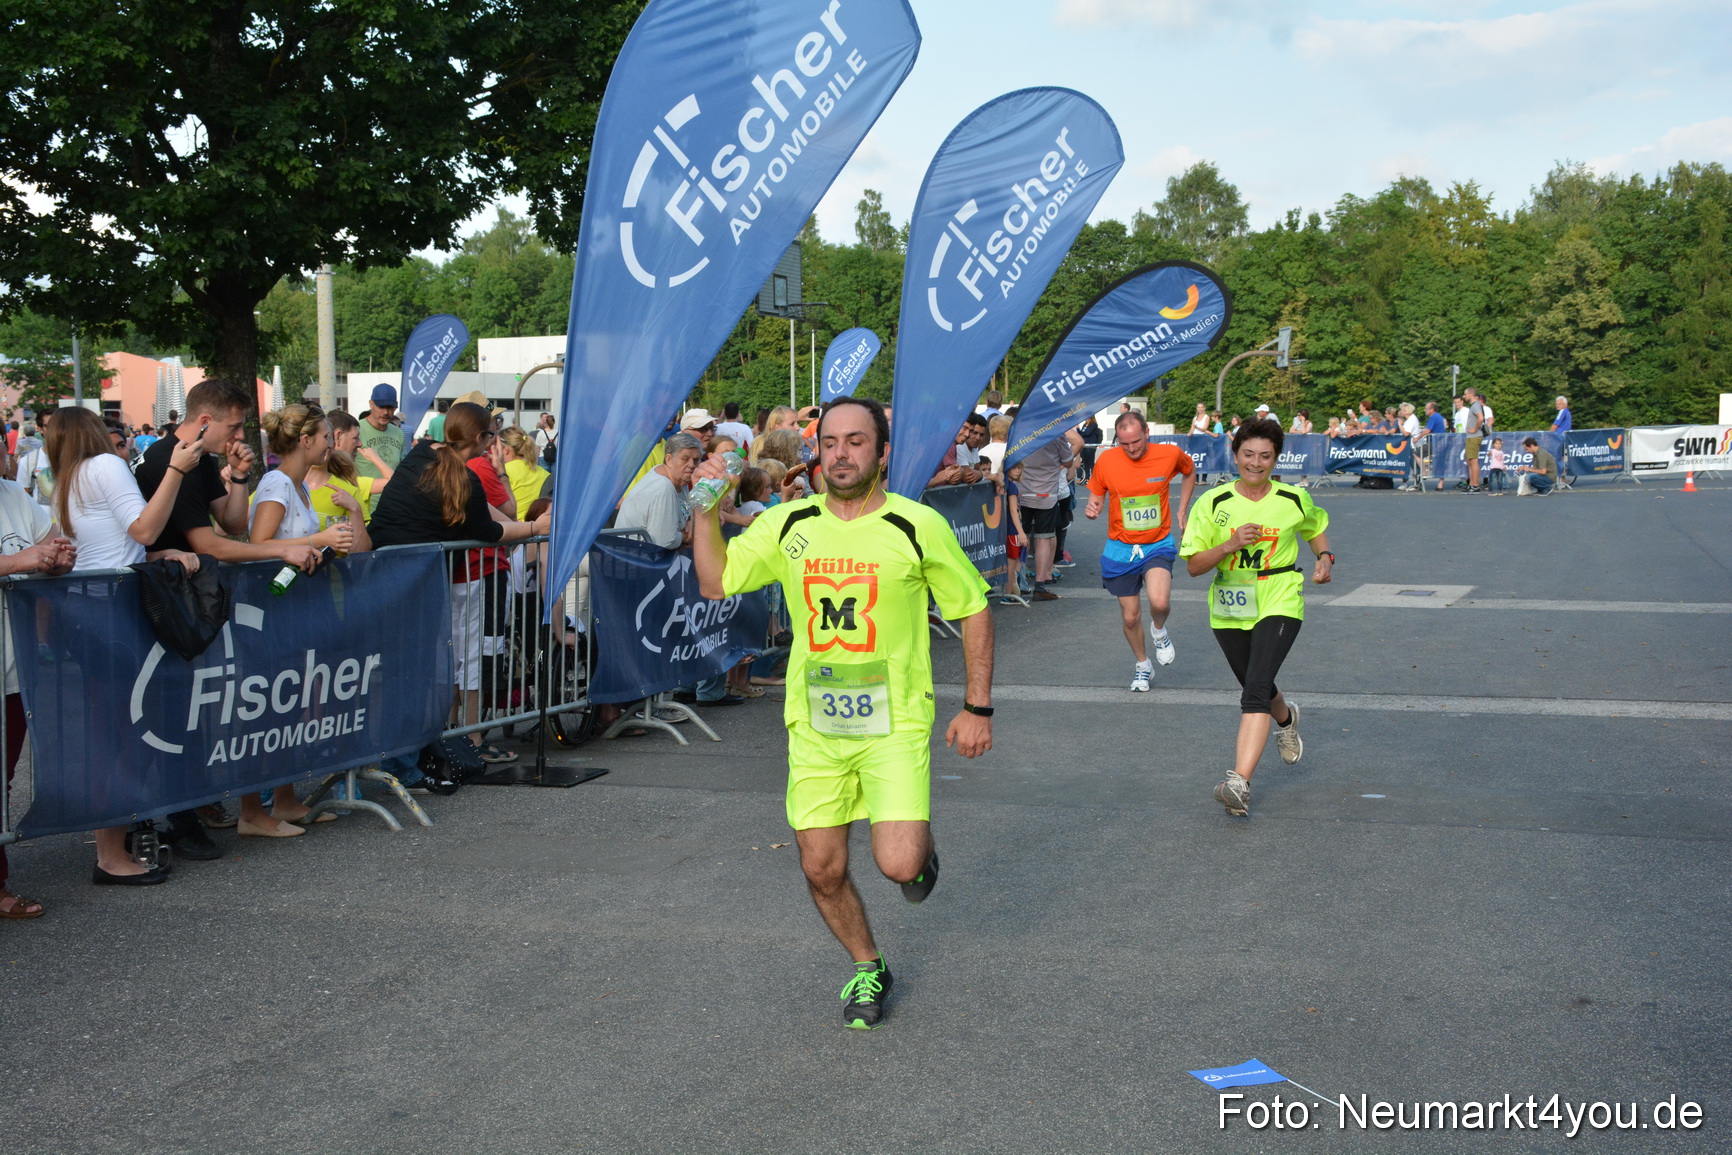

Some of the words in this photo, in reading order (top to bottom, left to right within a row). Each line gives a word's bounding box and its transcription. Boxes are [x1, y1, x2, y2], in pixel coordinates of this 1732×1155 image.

[664, 0, 848, 246] Fischer
[729, 48, 868, 245] AUTOMOBILE
[957, 126, 1075, 301] Fischer
[999, 159, 1090, 299] AUTOMOBILE
[416, 327, 454, 385] Fischer
[429, 338, 460, 384] AUTOMOBILE
[835, 338, 868, 386] Fischer
[1041, 322, 1174, 403] Frischmann
[1126, 347, 1159, 369] Druck
[1159, 337, 1181, 352] und
[1180, 313, 1219, 342] Medien
[846, 346, 872, 385] AUTOMOBILE
[1004, 400, 1087, 460] www.frischmann-net.de
[1329, 447, 1387, 459] Frischmann
[1568, 443, 1610, 457] Frischmann
[1673, 437, 1717, 457] swn
[1277, 451, 1308, 463] cher
[1126, 508, 1157, 521] 1040
[803, 558, 880, 575] Müller
[1238, 549, 1264, 569] M
[819, 597, 858, 631] M
[1218, 589, 1247, 606] 336
[186, 648, 381, 732] Fischer
[822, 693, 874, 719] 338
[206, 707, 367, 767] AUTOMOBILE
